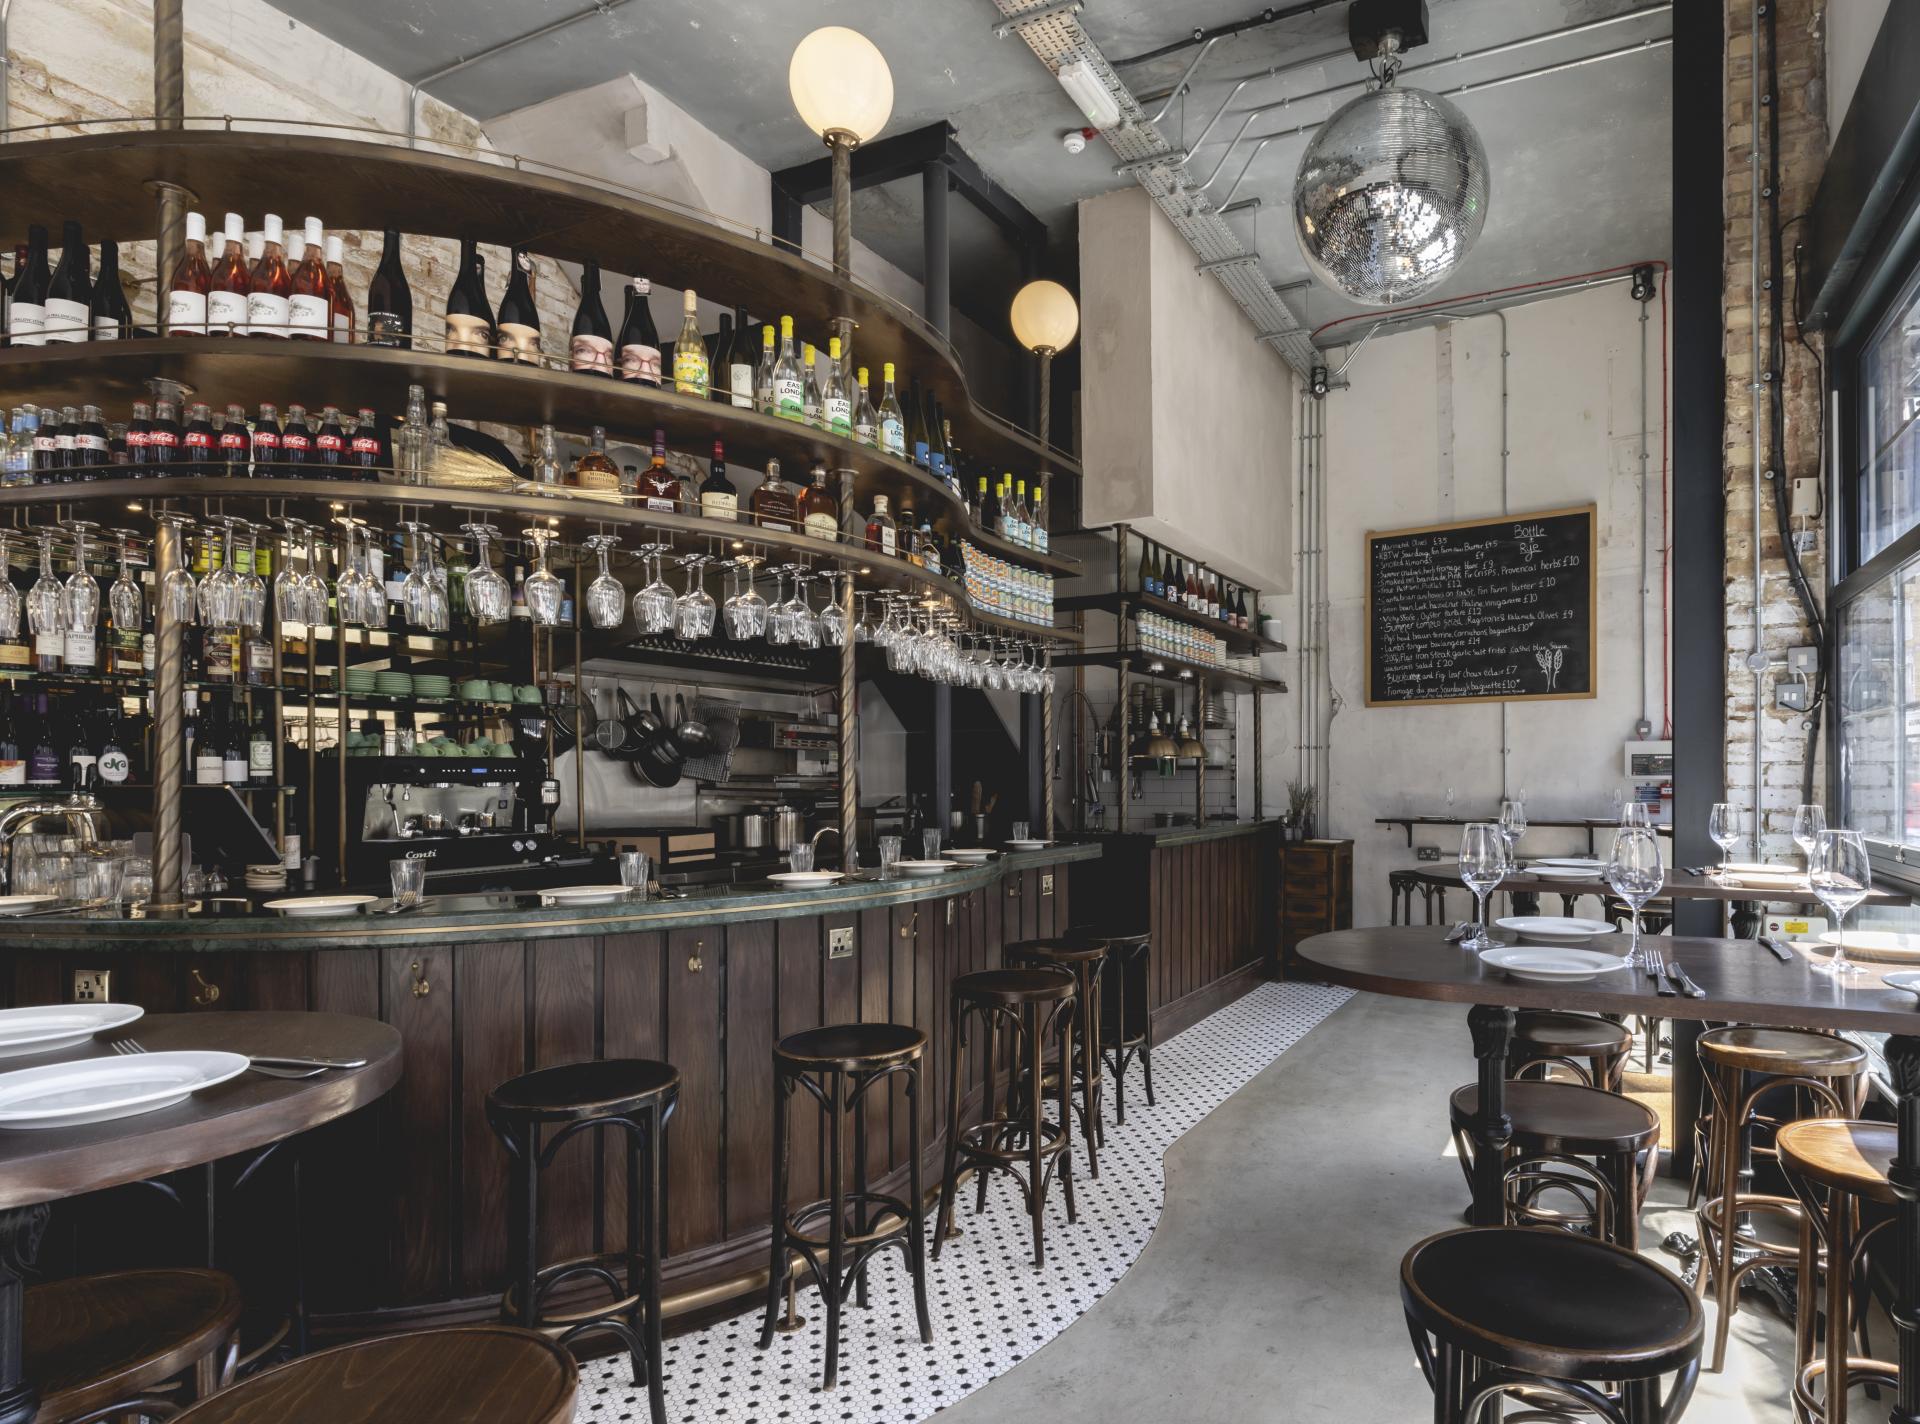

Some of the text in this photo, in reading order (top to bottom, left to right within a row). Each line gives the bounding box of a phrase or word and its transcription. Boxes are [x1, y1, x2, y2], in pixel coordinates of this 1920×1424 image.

[1514, 524, 1545, 538] Bottle
[1520, 542, 1540, 562] Rye
[1562, 555, 1580, 567] £10
[1538, 576, 1556, 588] £10
[1522, 594, 1538, 604] £10
[1468, 607, 1482, 616] £12
[1562, 609, 1573, 620] £9
[1506, 665, 1518, 675] £7
[405, 848, 437, 859] Conti
